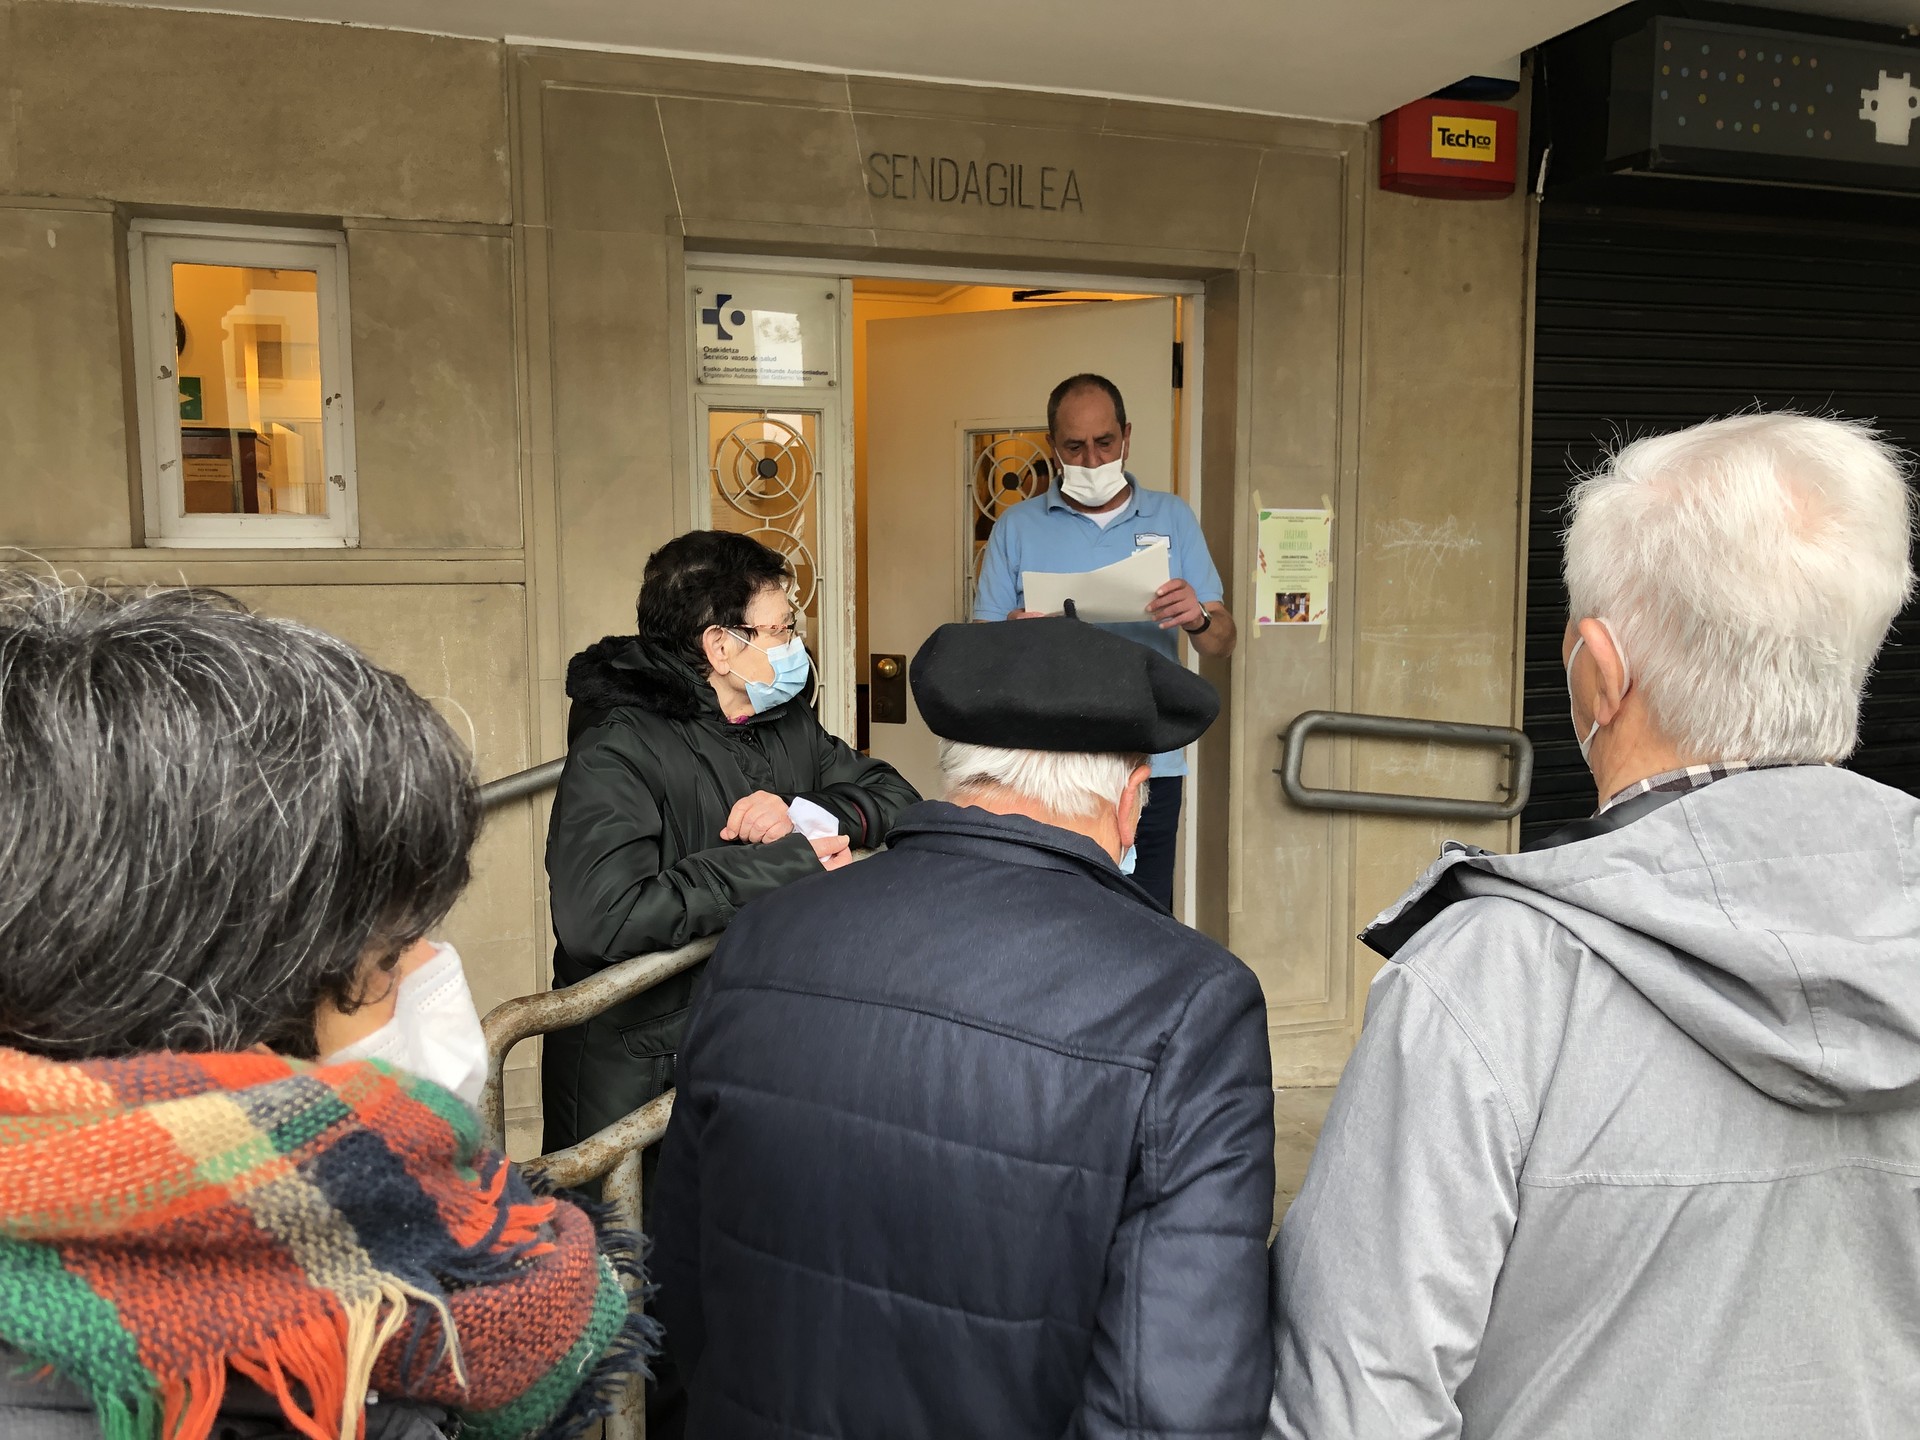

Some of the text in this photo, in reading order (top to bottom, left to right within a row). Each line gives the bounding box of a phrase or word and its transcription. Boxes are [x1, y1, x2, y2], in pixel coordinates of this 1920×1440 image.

[867, 152, 1084, 212] SENDAGILEA
[703, 345, 740, 353] Osakidetza
[703, 353, 729, 361] Servicio
